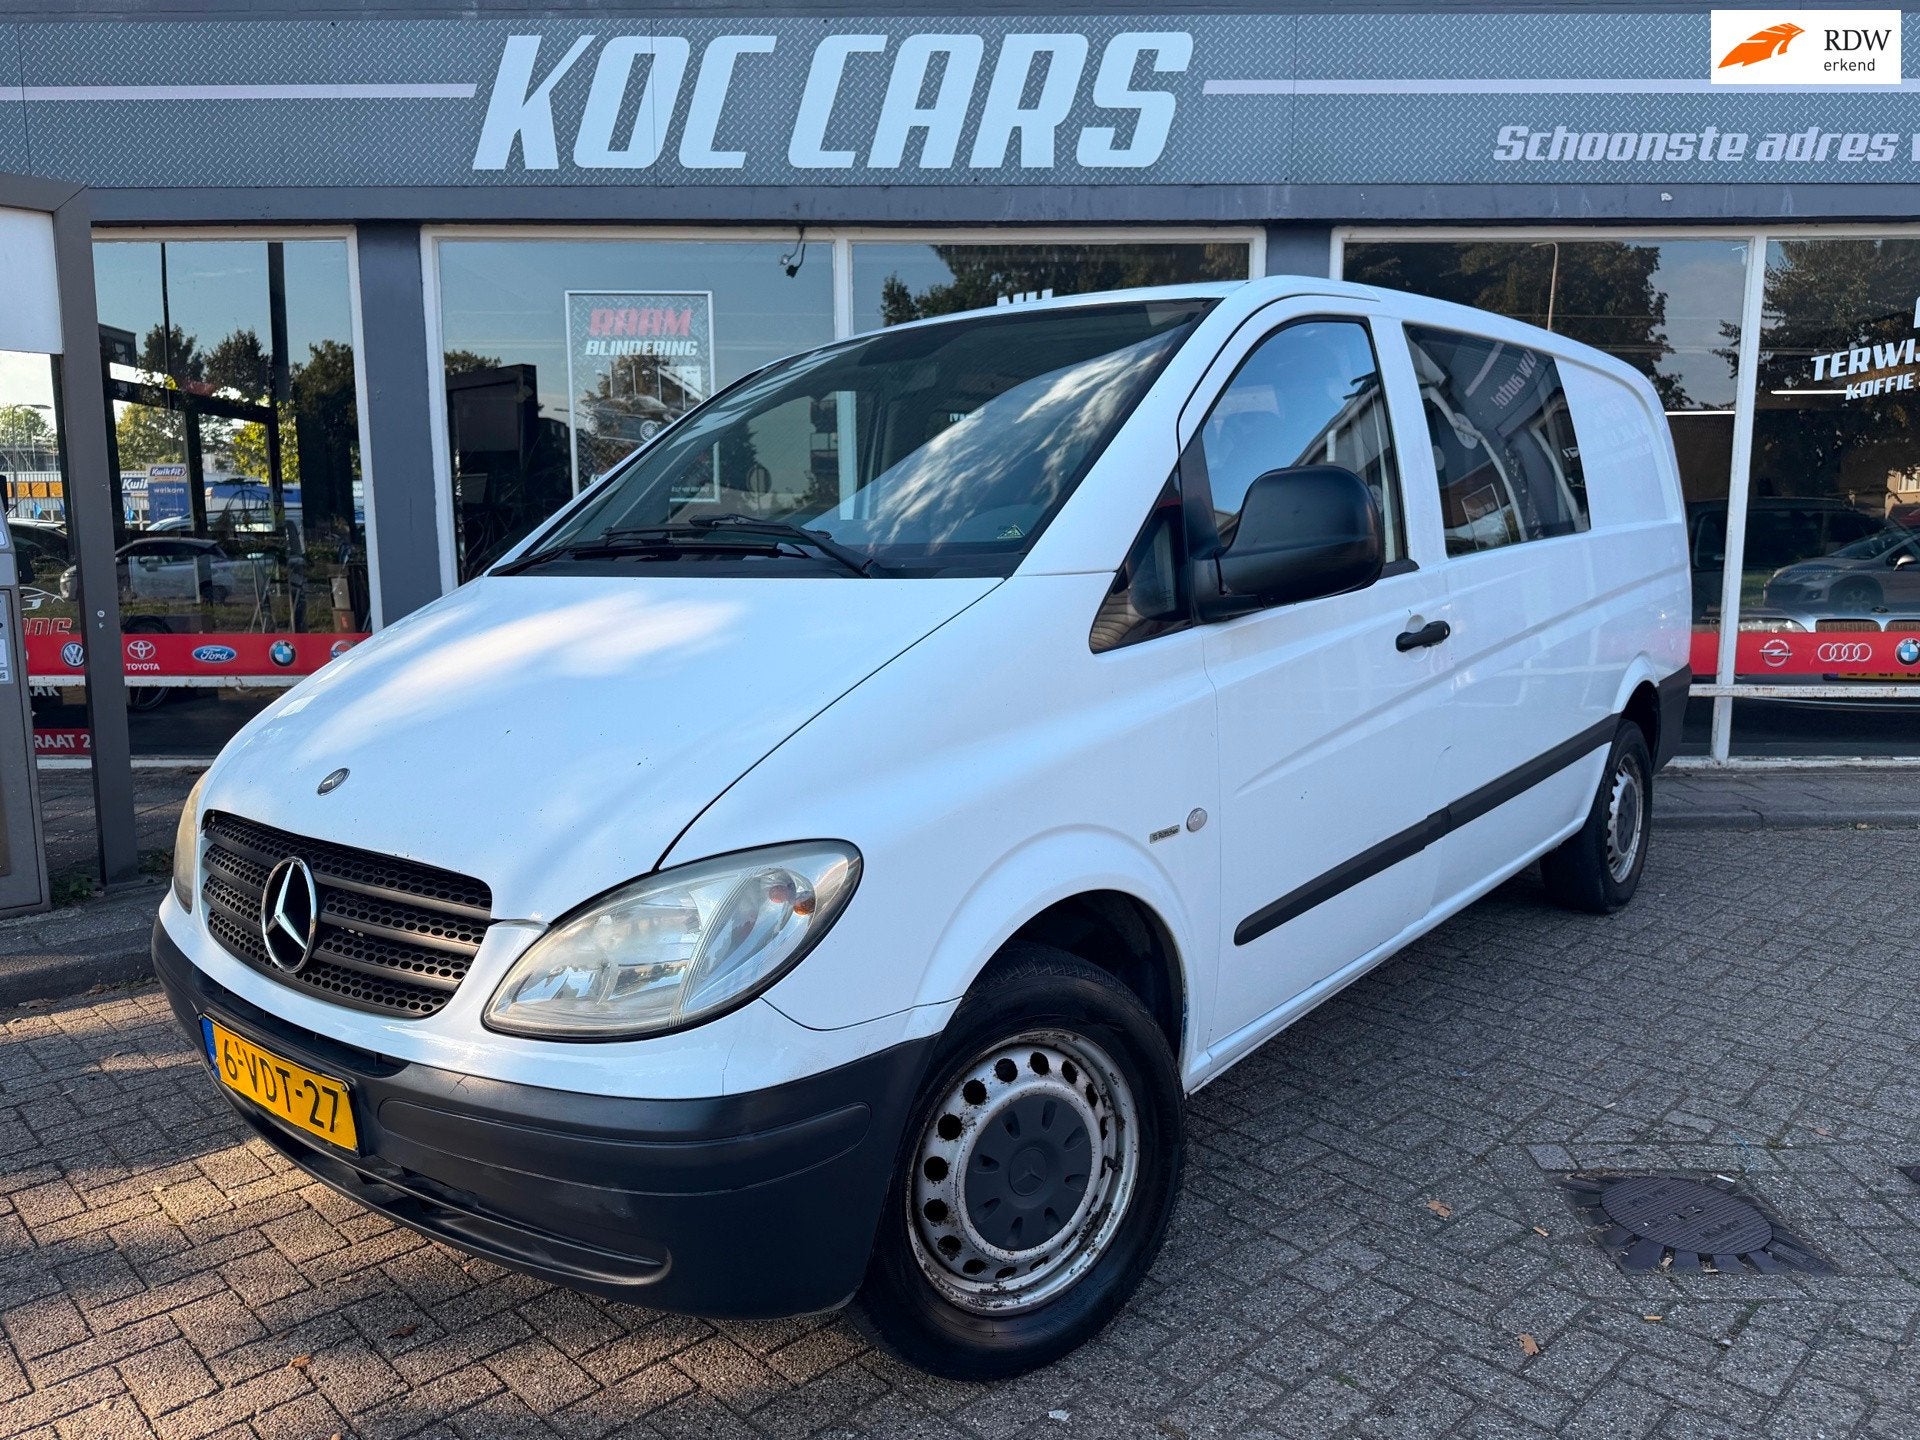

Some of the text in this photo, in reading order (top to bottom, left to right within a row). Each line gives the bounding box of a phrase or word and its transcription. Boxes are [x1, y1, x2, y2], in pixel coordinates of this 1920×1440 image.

[473, 31, 1194, 170] KOC CARS
[1493, 125, 1749, 162] Schoonste
[1755, 126, 1899, 162] adres
[588, 307, 694, 337] RAAM
[585, 339, 698, 356] BLINDERING
[1845, 372, 1916, 400] KOFFIE
[126, 663, 160, 671] TOYOTA
[200, 647, 229, 661] Ford
[223, 1037, 339, 1134] 6-VDT-27
